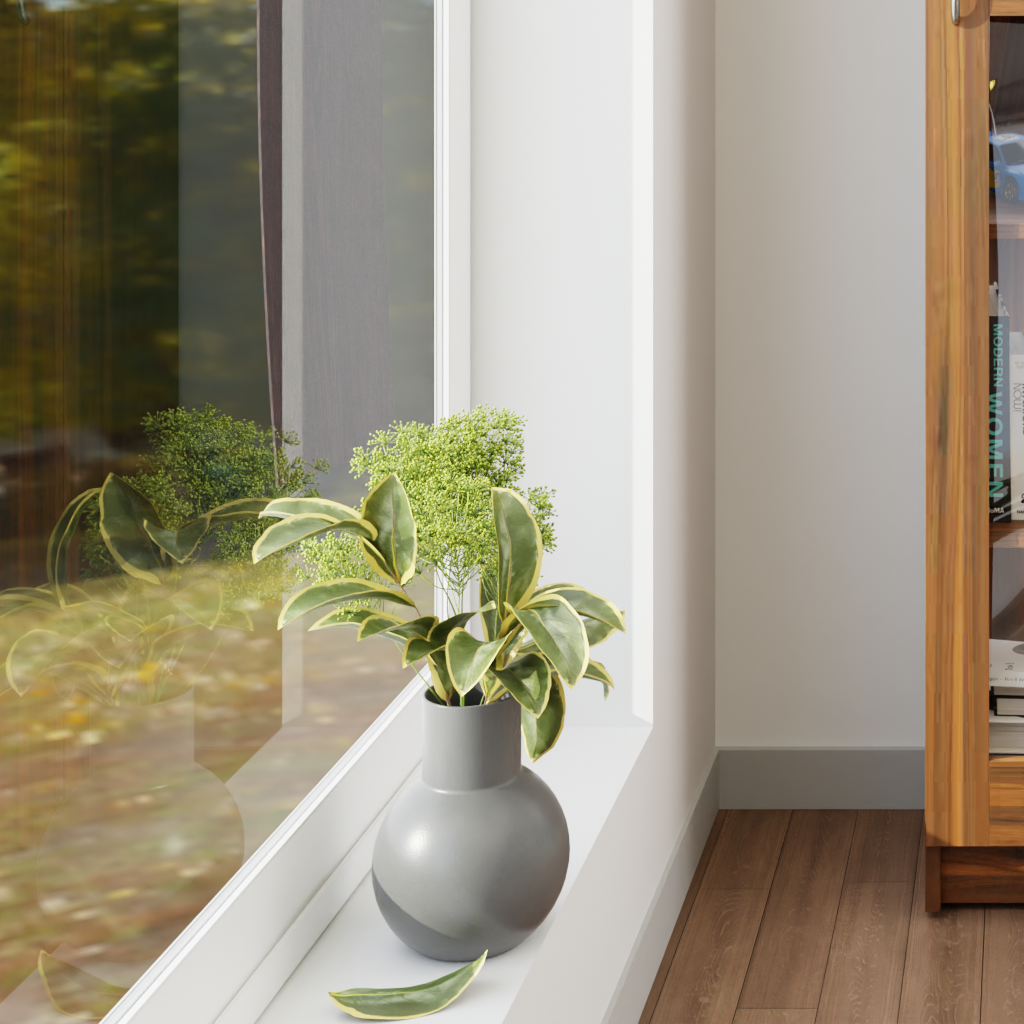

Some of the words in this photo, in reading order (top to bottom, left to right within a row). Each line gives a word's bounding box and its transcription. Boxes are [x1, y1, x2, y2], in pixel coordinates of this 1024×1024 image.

[993, 324, 1003, 387] MODERN
[1013, 383, 1022, 412] NOW!
[989, 391, 1003, 498] WOMEN
